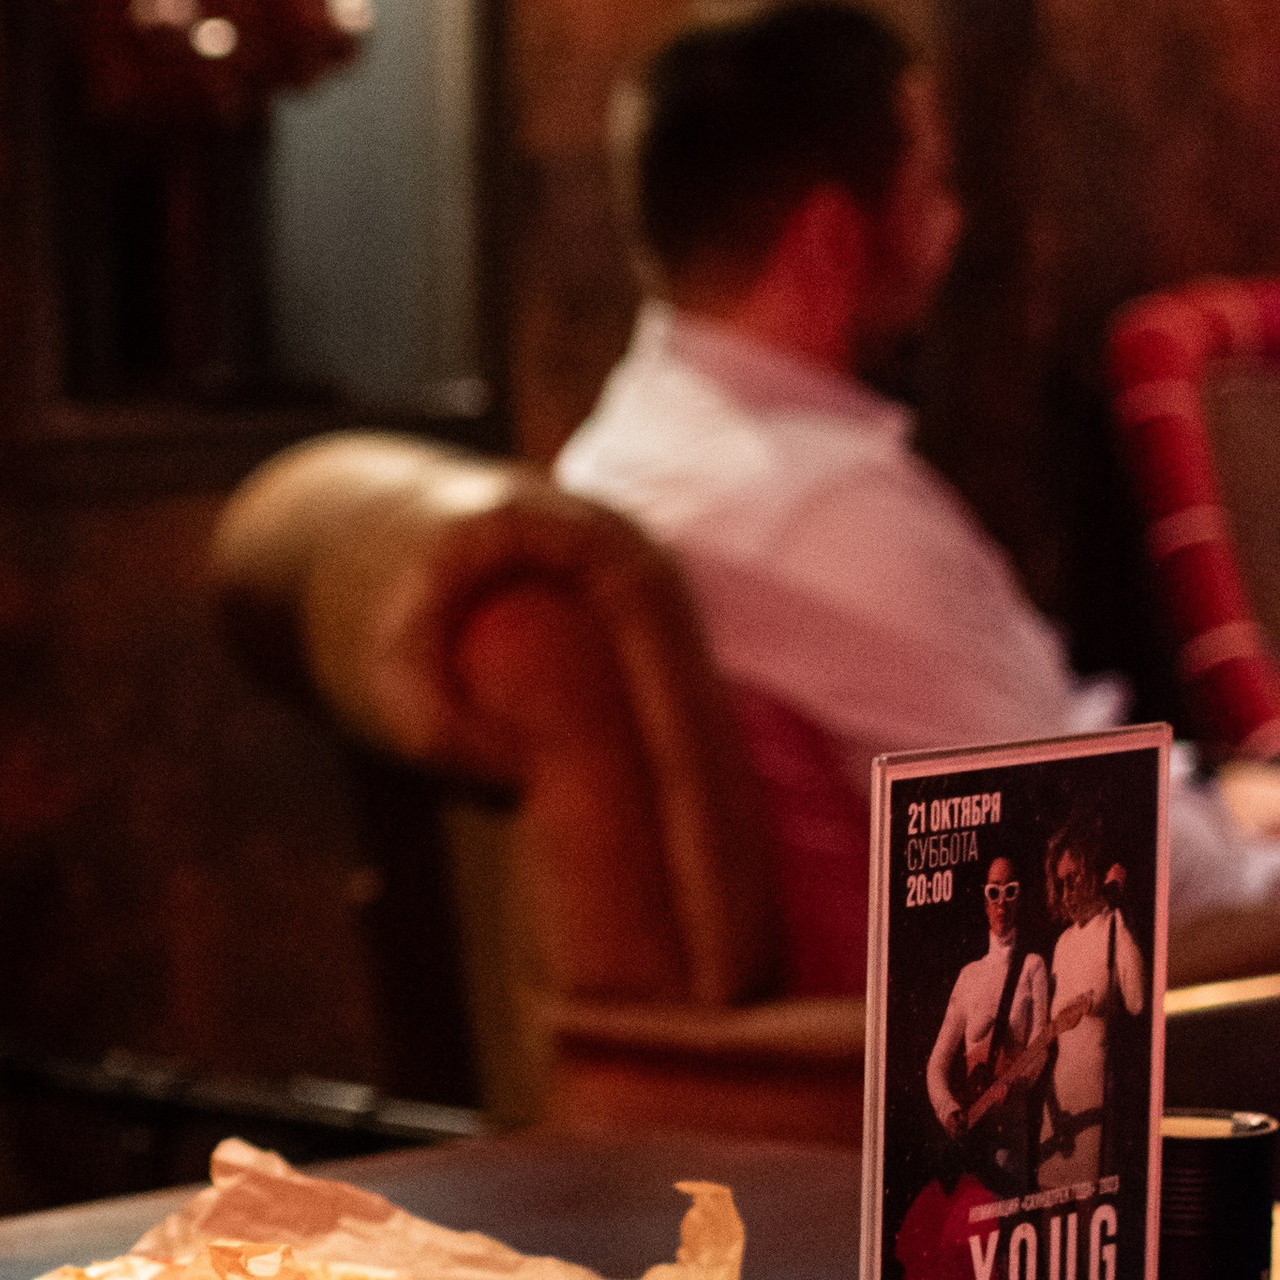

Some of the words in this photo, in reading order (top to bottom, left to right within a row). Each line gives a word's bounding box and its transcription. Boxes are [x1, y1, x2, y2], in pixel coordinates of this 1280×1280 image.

[907, 801, 926, 835] 21
[929, 791, 1002, 832] ОКТЯБРЯ
[906, 830, 979, 871] СУББОТА
[905, 868, 954, 908] 20:00
